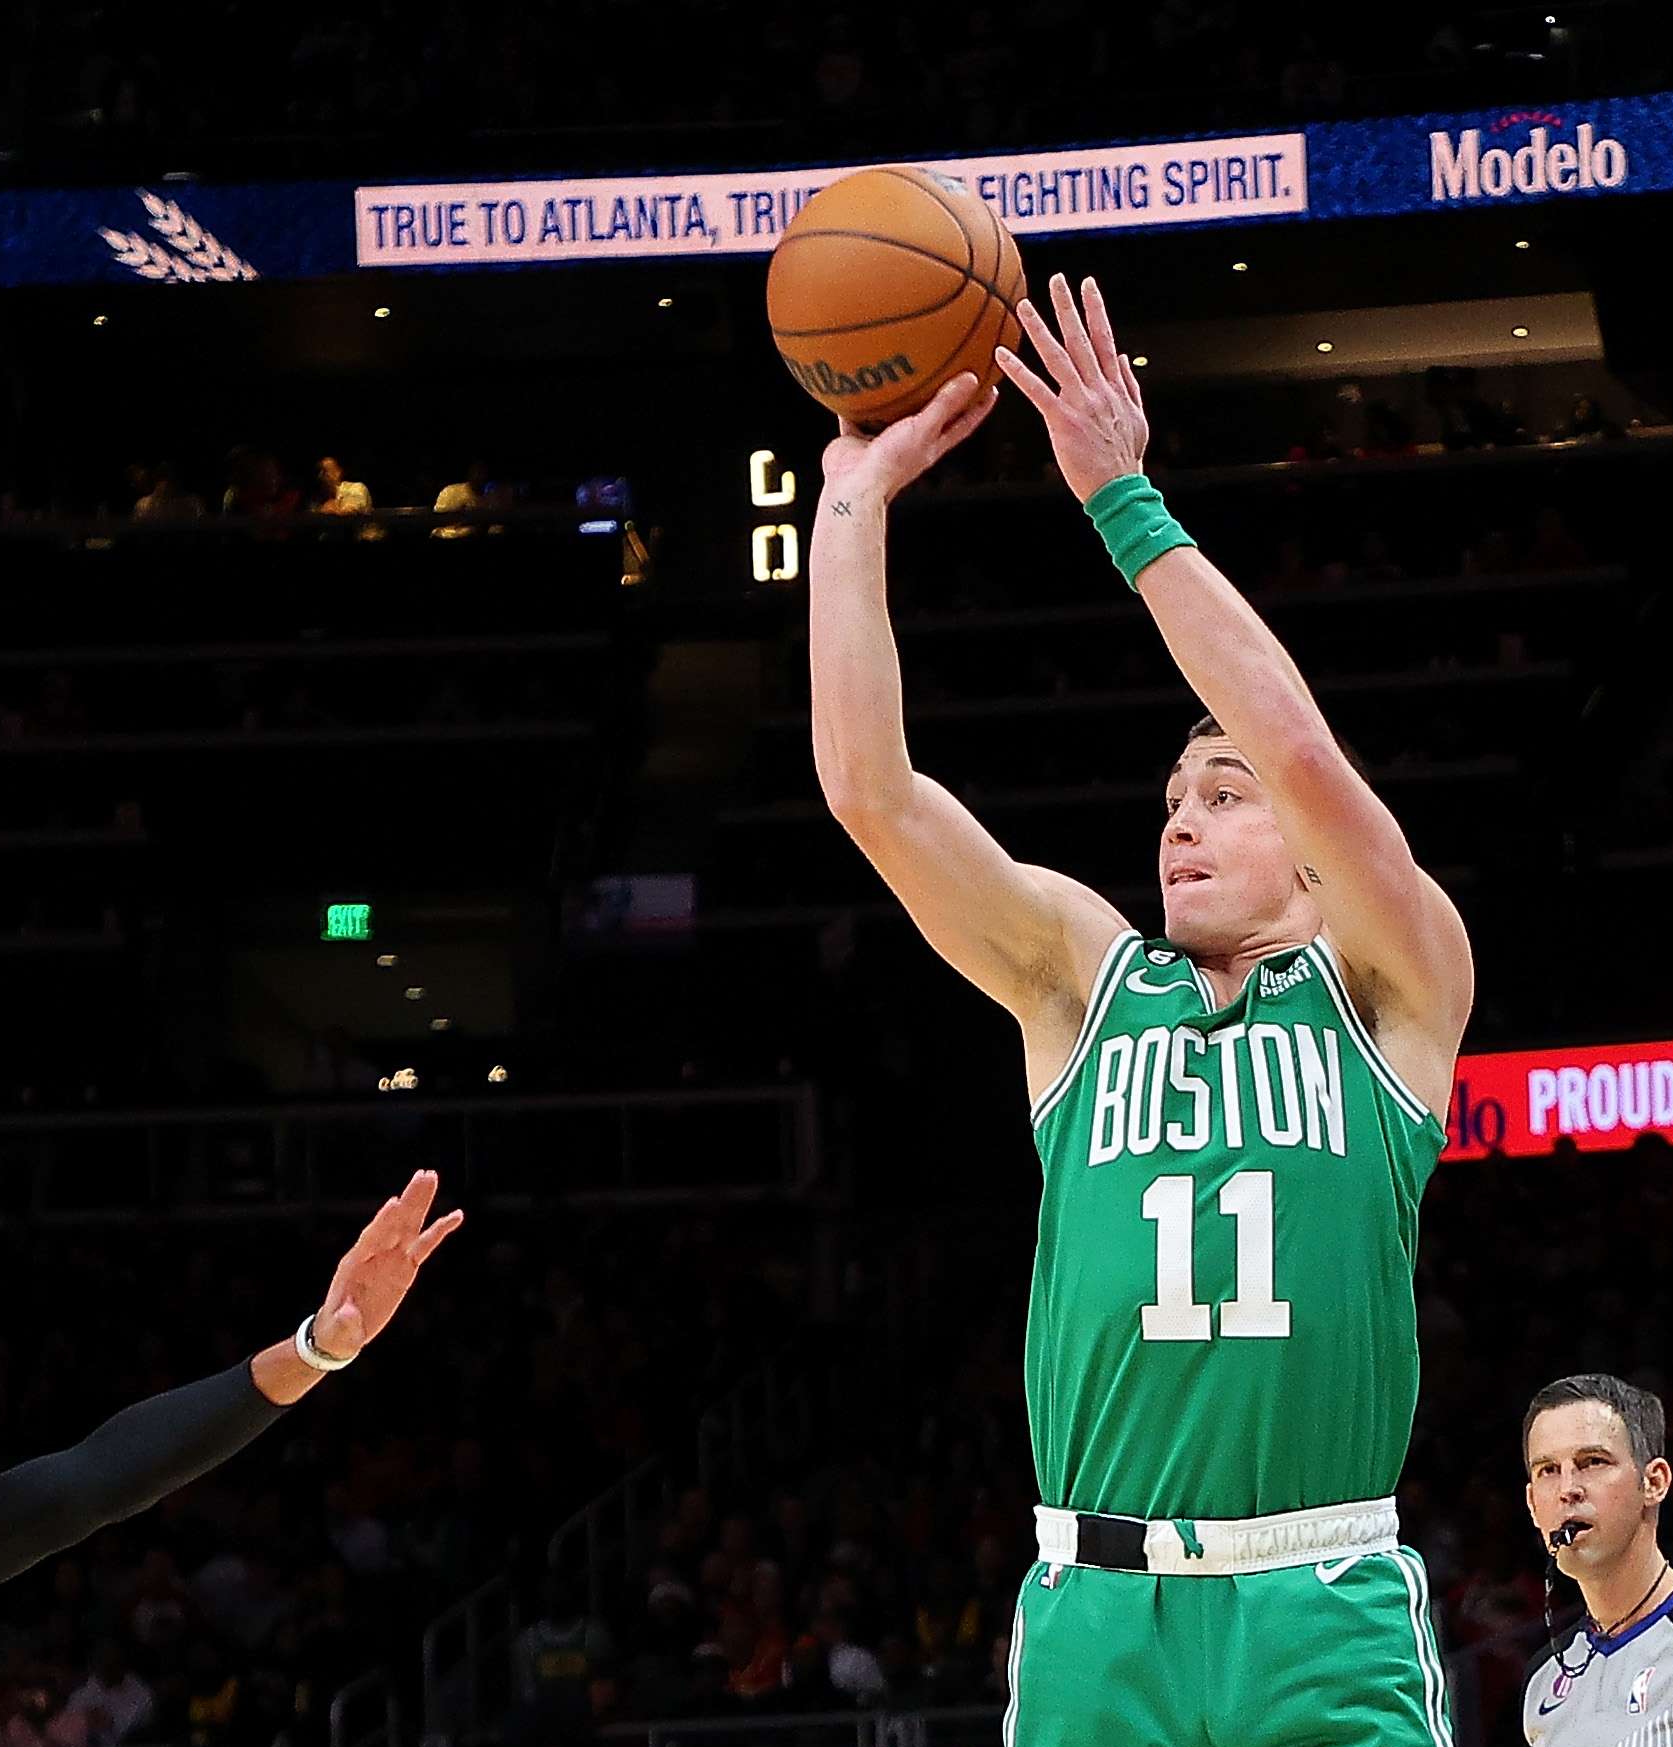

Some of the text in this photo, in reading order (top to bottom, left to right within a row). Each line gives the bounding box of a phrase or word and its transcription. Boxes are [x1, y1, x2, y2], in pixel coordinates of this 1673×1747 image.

[368, 152, 1291, 249] TRUE TO ATLANTA, TRU FIGHTING SPIRIT.
[1429, 124, 1627, 201] Modelo
[1088, 1023, 1347, 1168] BOSTON
[1141, 1170, 1292, 1341] 11
